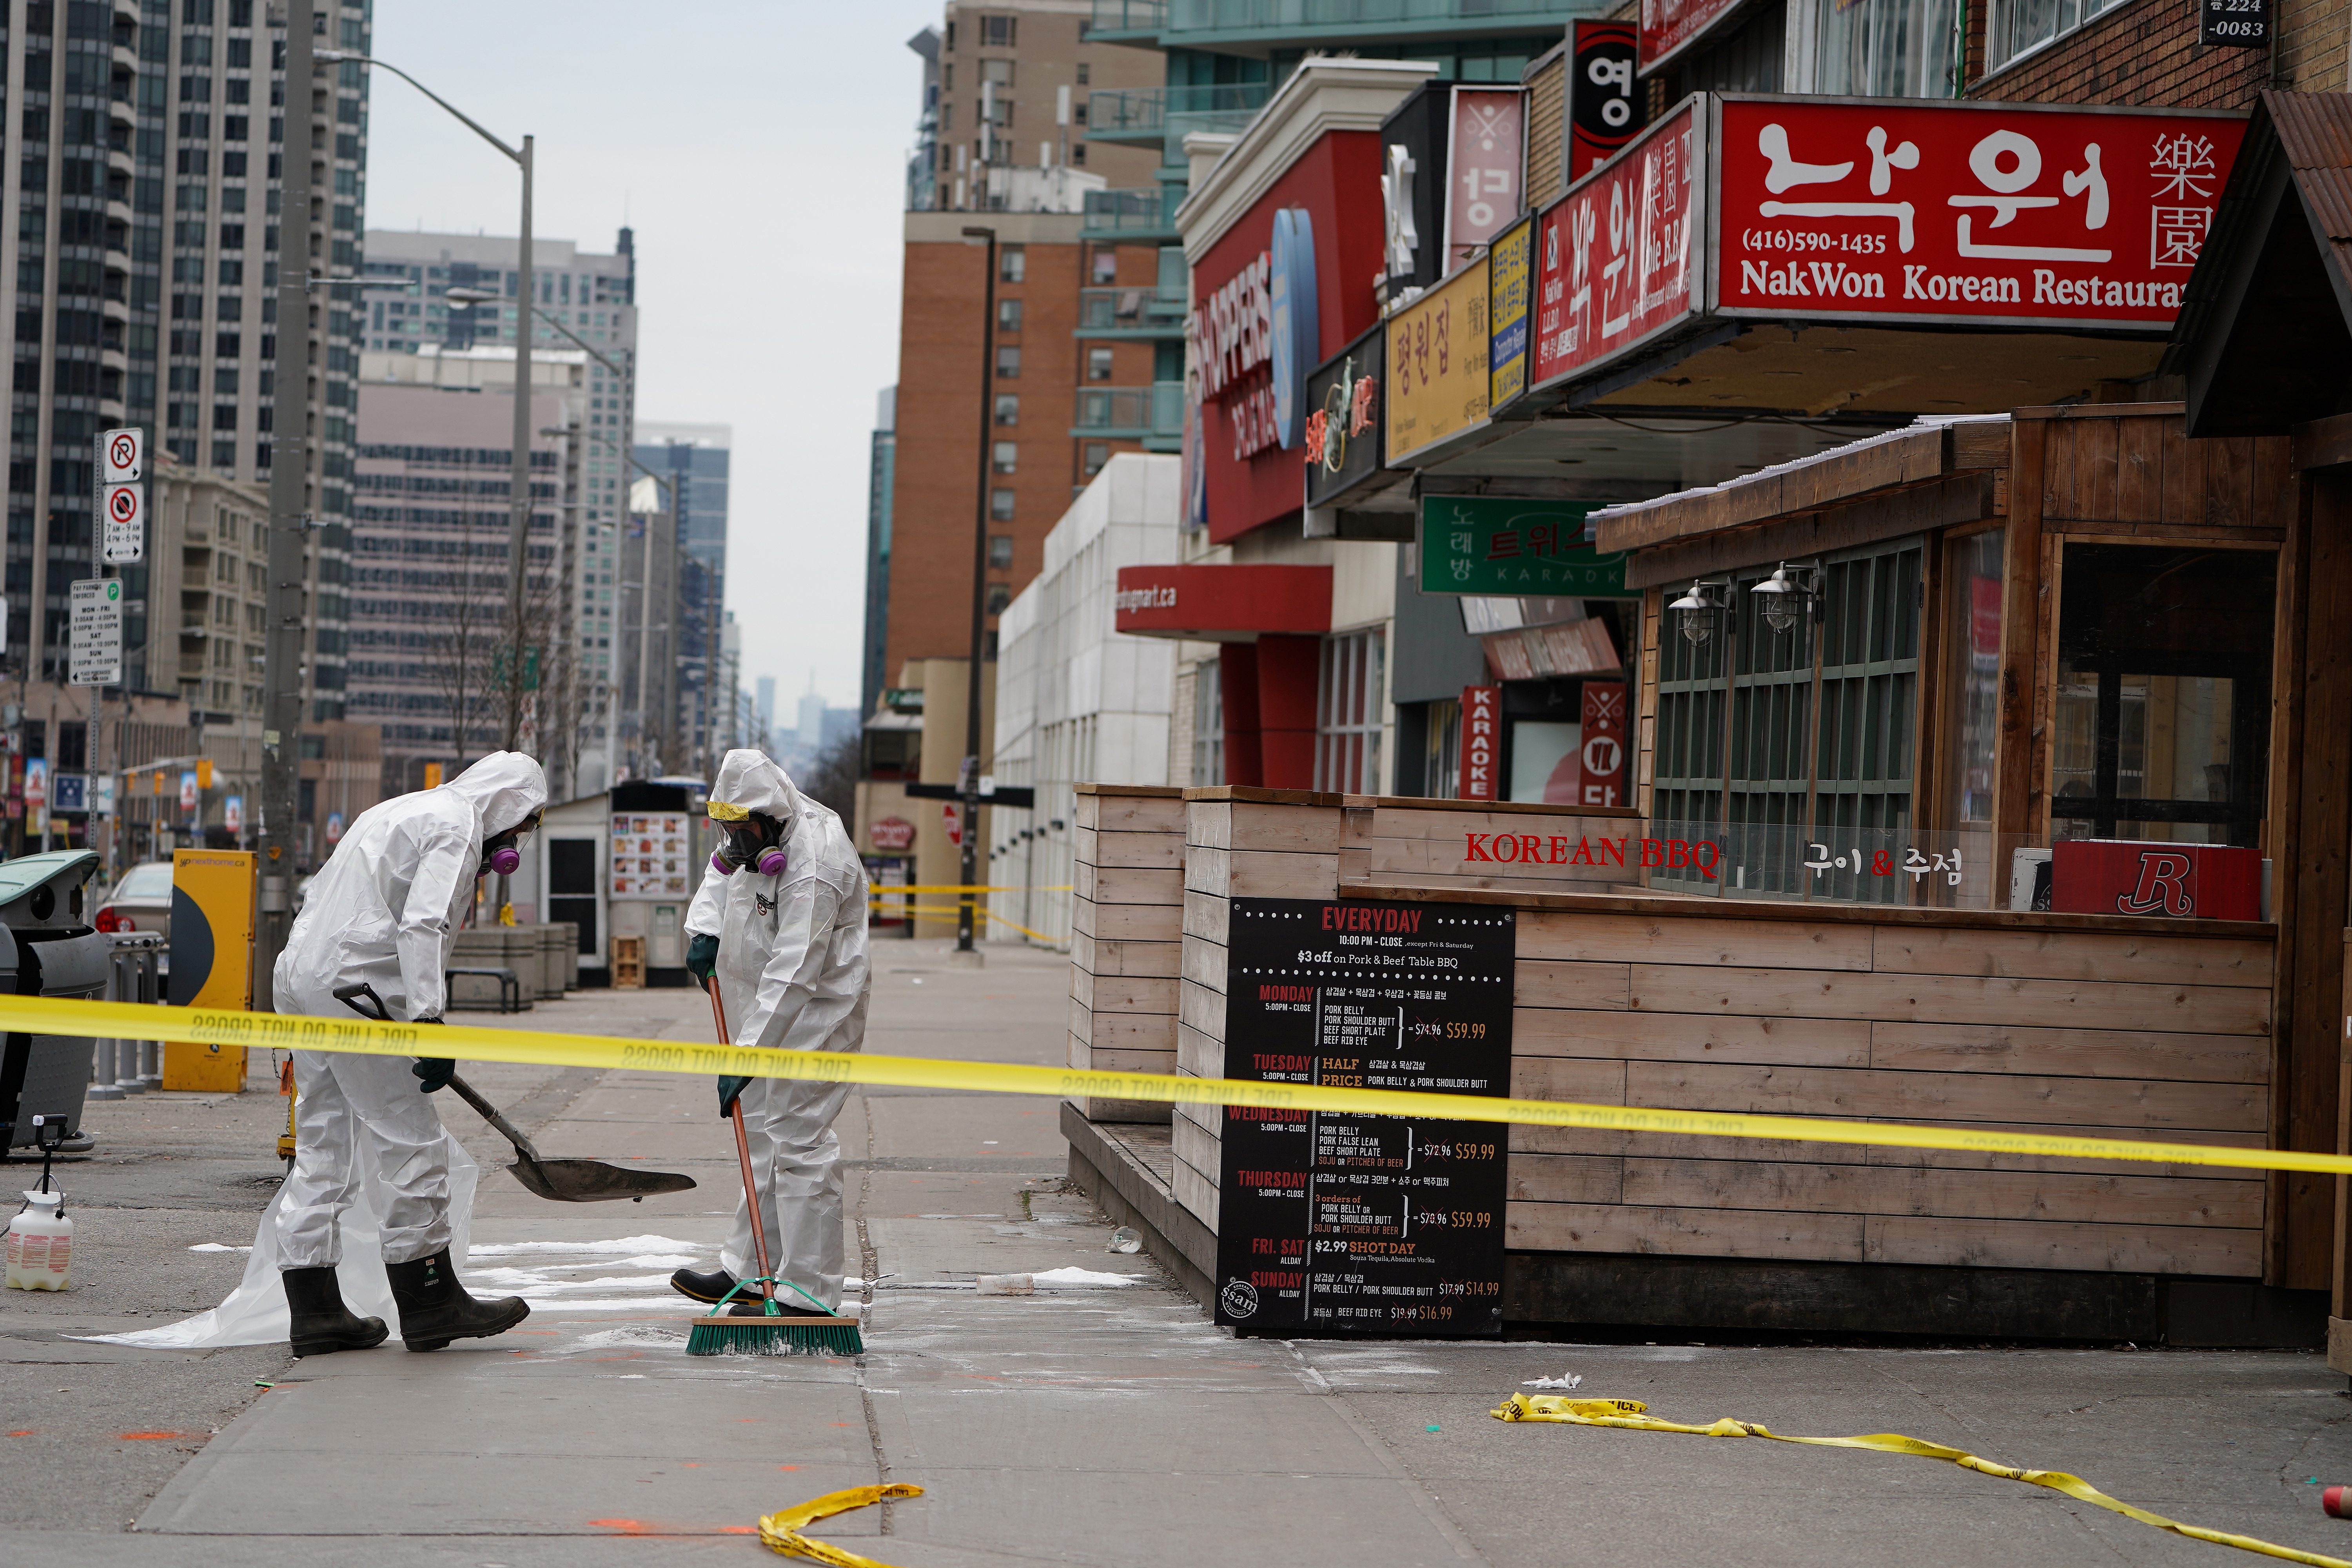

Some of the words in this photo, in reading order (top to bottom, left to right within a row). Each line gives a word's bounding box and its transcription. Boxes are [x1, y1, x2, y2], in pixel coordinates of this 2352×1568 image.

[2226, 0, 2261, 12] 224
[2209, 21, 2263, 36] -0083
[1588, 57, 1632, 127] 영
[1759, 123, 2112, 262] 낙원
[2149, 133, 2216, 270] 樂園
[1743, 228, 1886, 254] (416)590-1435
[1740, 260, 1885, 298] NakWon
[1903, 265, 2021, 303] Korean
[1191, 250, 1271, 405] SHOPPERS
[1397, 298, 1449, 396] 평원집
[107, 523, 111, 533] 7
[106, 534, 111, 544] 4
[126, 533, 130, 542] 6
[1451, 505, 1474, 581] 노래방
[1471, 689, 1492, 796] KARAOKE
[1464, 833, 1628, 868] KOREAN
[1639, 838, 1719, 878] BBQ
[1804, 844, 1861, 878] 구이
[1871, 849, 1894, 877] &
[1902, 848, 1962, 886] 주점
[1322, 907, 1421, 933] EVERYDAY
[1339, 935, 1359, 945] 10:00
[1361, 936, 1372, 945] PM
[1381, 937, 1402, 946] CLOSE
[1298, 950, 1312, 962] $3
[1314, 951, 1332, 962] off
[1349, 955, 1371, 964] Pork
[1383, 956, 1405, 965] Beef
[1409, 957, 1434, 966] Table
[1437, 958, 1457, 969] BBQ
[1260, 985, 1313, 1002] MONDAY
[1326, 987, 1346, 996] 삼겹살
[1356, 988, 1374, 997] 목삼겹
[1385, 989, 1403, 998] 우삼겹
[1414, 991, 1432, 999] 꽃등심
[1435, 991, 1446, 1000] 콤보
[1325, 1005, 1341, 1014] PORK
[1344, 1006, 1364, 1014] BELLY
[1325, 1015, 1341, 1024] PORK
[1344, 1016, 1376, 1025] SHOULDER
[1379, 1017, 1395, 1026] BUTT
[1324, 1025, 1339, 1034] BEEF
[1342, 1026, 1362, 1034] SHORT
[1365, 1027, 1385, 1036] PLATE
[1447, 1022, 1485, 1039] $59.99
[1324, 1036, 1339, 1044] BEEF
[1341, 1036, 1353, 1045] RIB
[1356, 1037, 1367, 1045] EYE
[1253, 1054, 1311, 1073] TUESDAY
[1323, 1058, 1359, 1069] HALF
[1369, 1060, 1389, 1069] 삼겹살
[1400, 1061, 1425, 1070] 목삼겹살
[1321, 1075, 1362, 1087] PRICE
[1228, 1106, 1308, 1122] WEDNESDAY
[1319, 1136, 1336, 1145] PORK
[1339, 1137, 1359, 1145] FALSE
[1362, 1138, 1378, 1146] LEAN
[1456, 1143, 1494, 1160] $59.99
[1319, 1156, 1335, 1165] SOJU
[1347, 1158, 1374, 1166] PITCHER
[1239, 1171, 1307, 1187] THURSDAY
[1452, 1210, 1490, 1228] $59.99
[1281, 1240, 1305, 1254] SAT
[1315, 1240, 1347, 1252] $2.99
[1349, 1241, 1387, 1253] SHOT
[1390, 1243, 1416, 1254] DAY
[1250, 1271, 1303, 1289] SUNDAY
[1466, 1281, 1498, 1295] $14.99
[1314, 1308, 1331, 1317] 꽃등심
[1338, 1308, 1353, 1316] BEEF
[1370, 1309, 1382, 1317] EYE
[1420, 1305, 1452, 1319] $16.99
